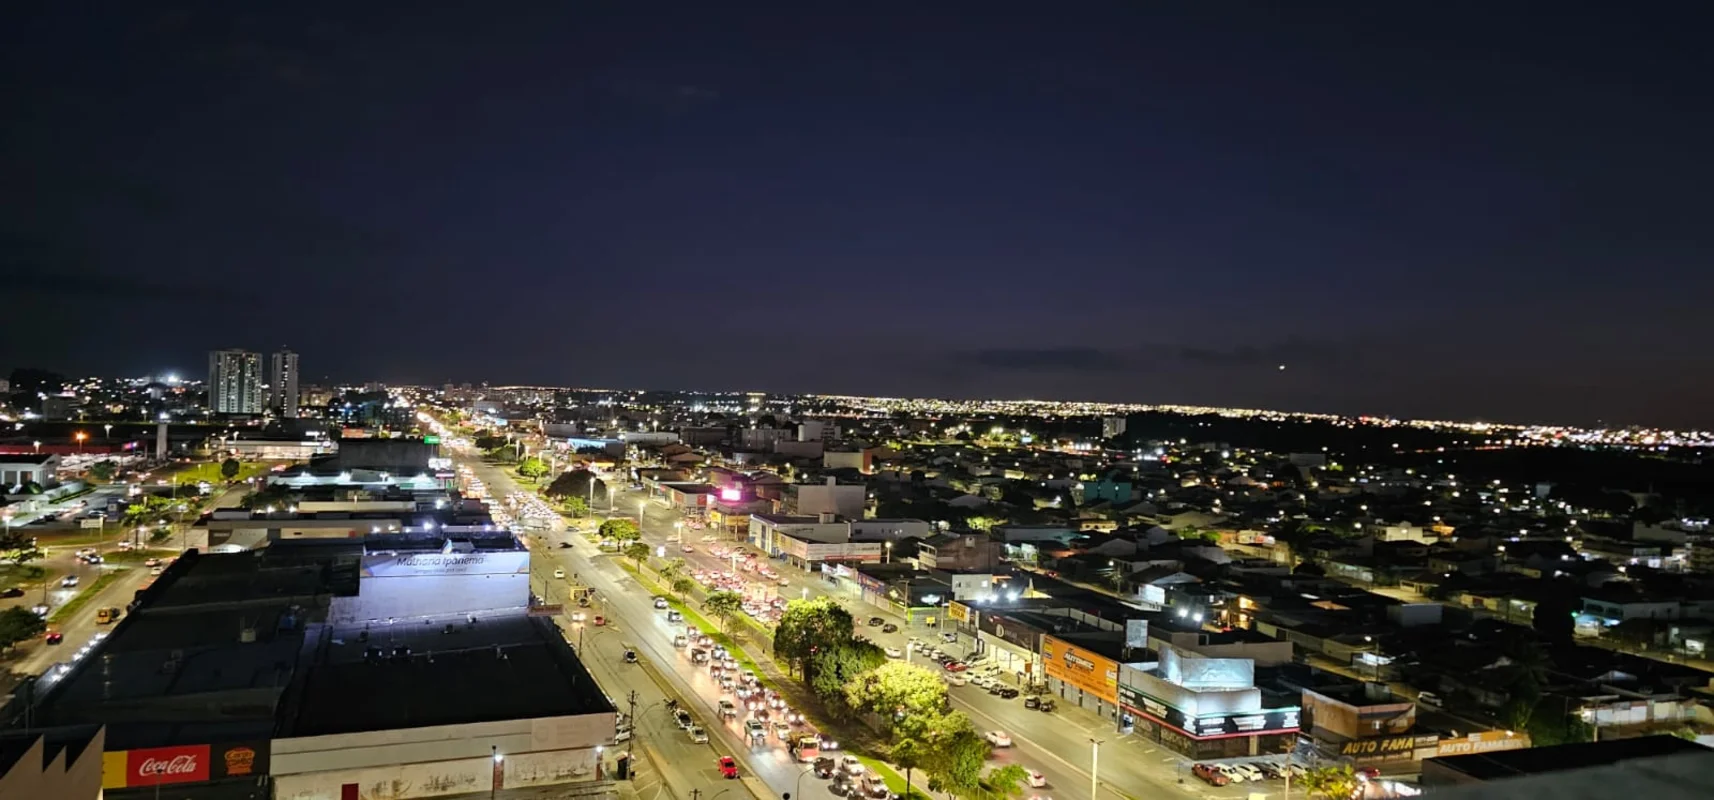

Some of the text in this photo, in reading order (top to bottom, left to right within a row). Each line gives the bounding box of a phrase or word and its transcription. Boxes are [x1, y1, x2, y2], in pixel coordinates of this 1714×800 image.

[1342, 741, 1377, 754] AUTO
[1380, 737, 1414, 752] FAMA
[1440, 742, 1472, 754] AUTO
